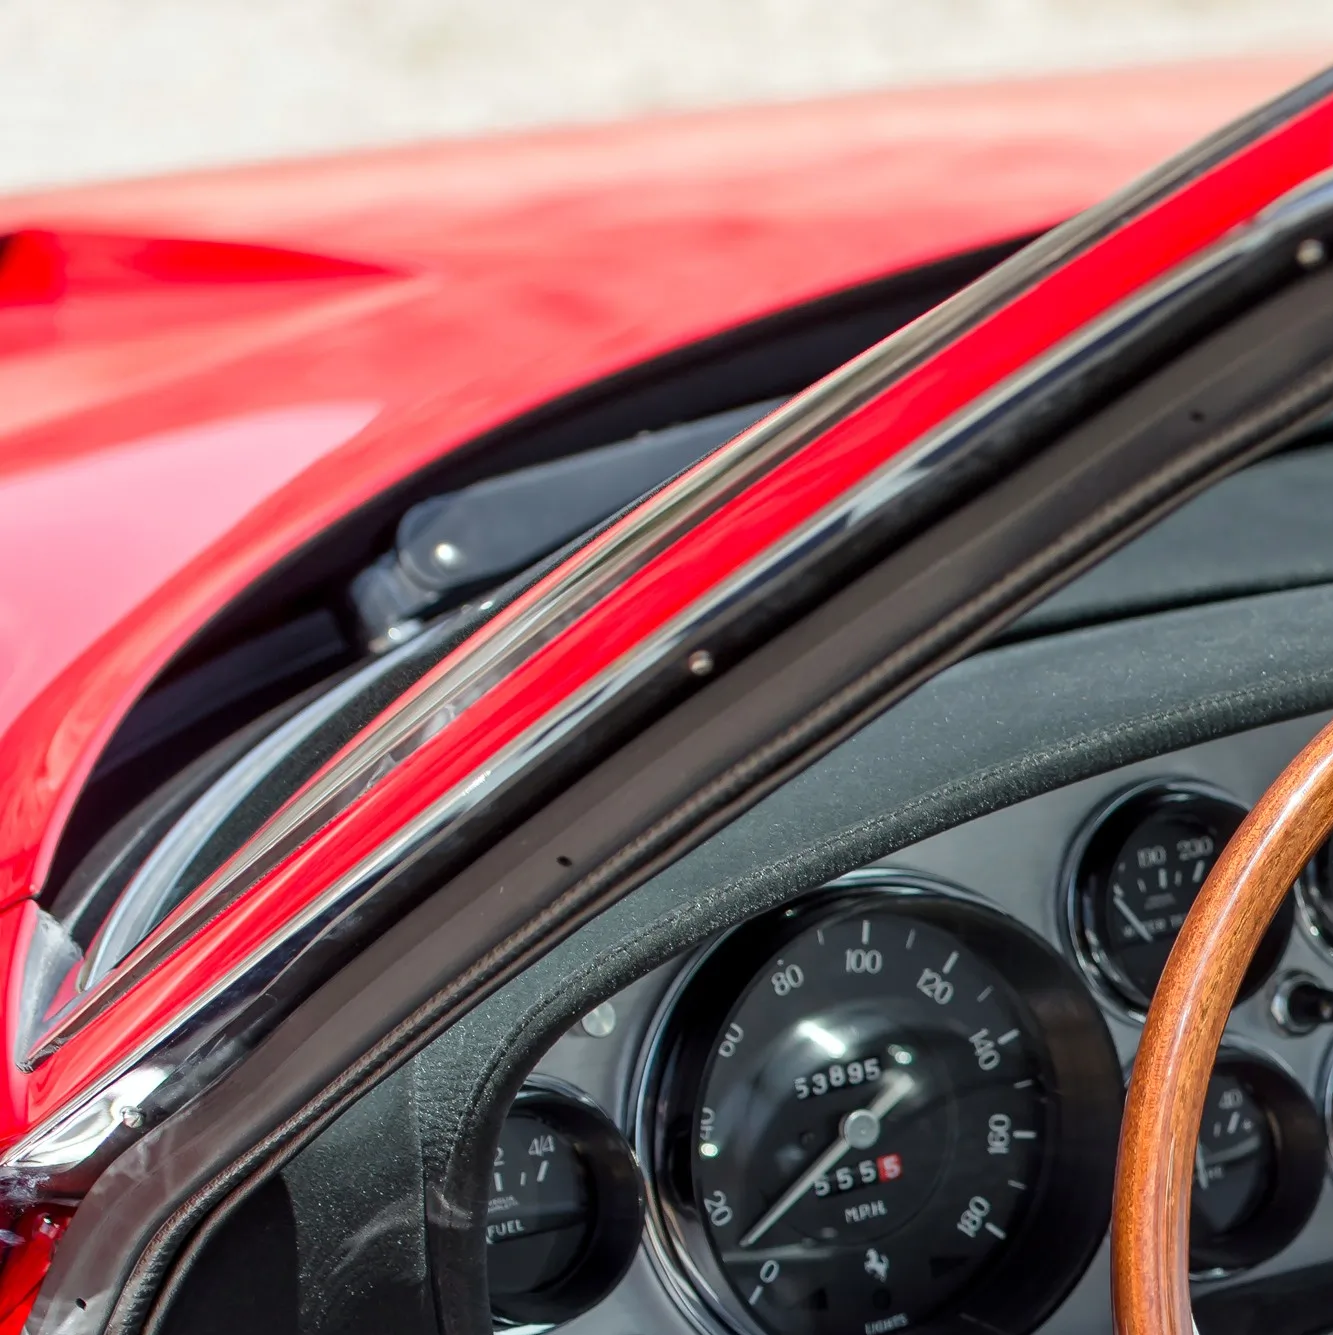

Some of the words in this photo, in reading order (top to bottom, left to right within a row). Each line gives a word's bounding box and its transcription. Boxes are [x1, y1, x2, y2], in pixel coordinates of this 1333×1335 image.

[770, 963, 805, 997] 80
[845, 948, 883, 975] 100
[915, 967, 955, 1005] 120
[968, 1027, 1001, 1071] 140
[793, 1057, 882, 1100] 53895
[527, 1134, 555, 1157] 4/4
[986, 1112, 1012, 1155] 160
[703, 1189, 734, 1227] 20
[956, 1195, 992, 1239] 180
[486, 1218, 525, 1238] FUEL
[758, 1259, 781, 1284] 0
